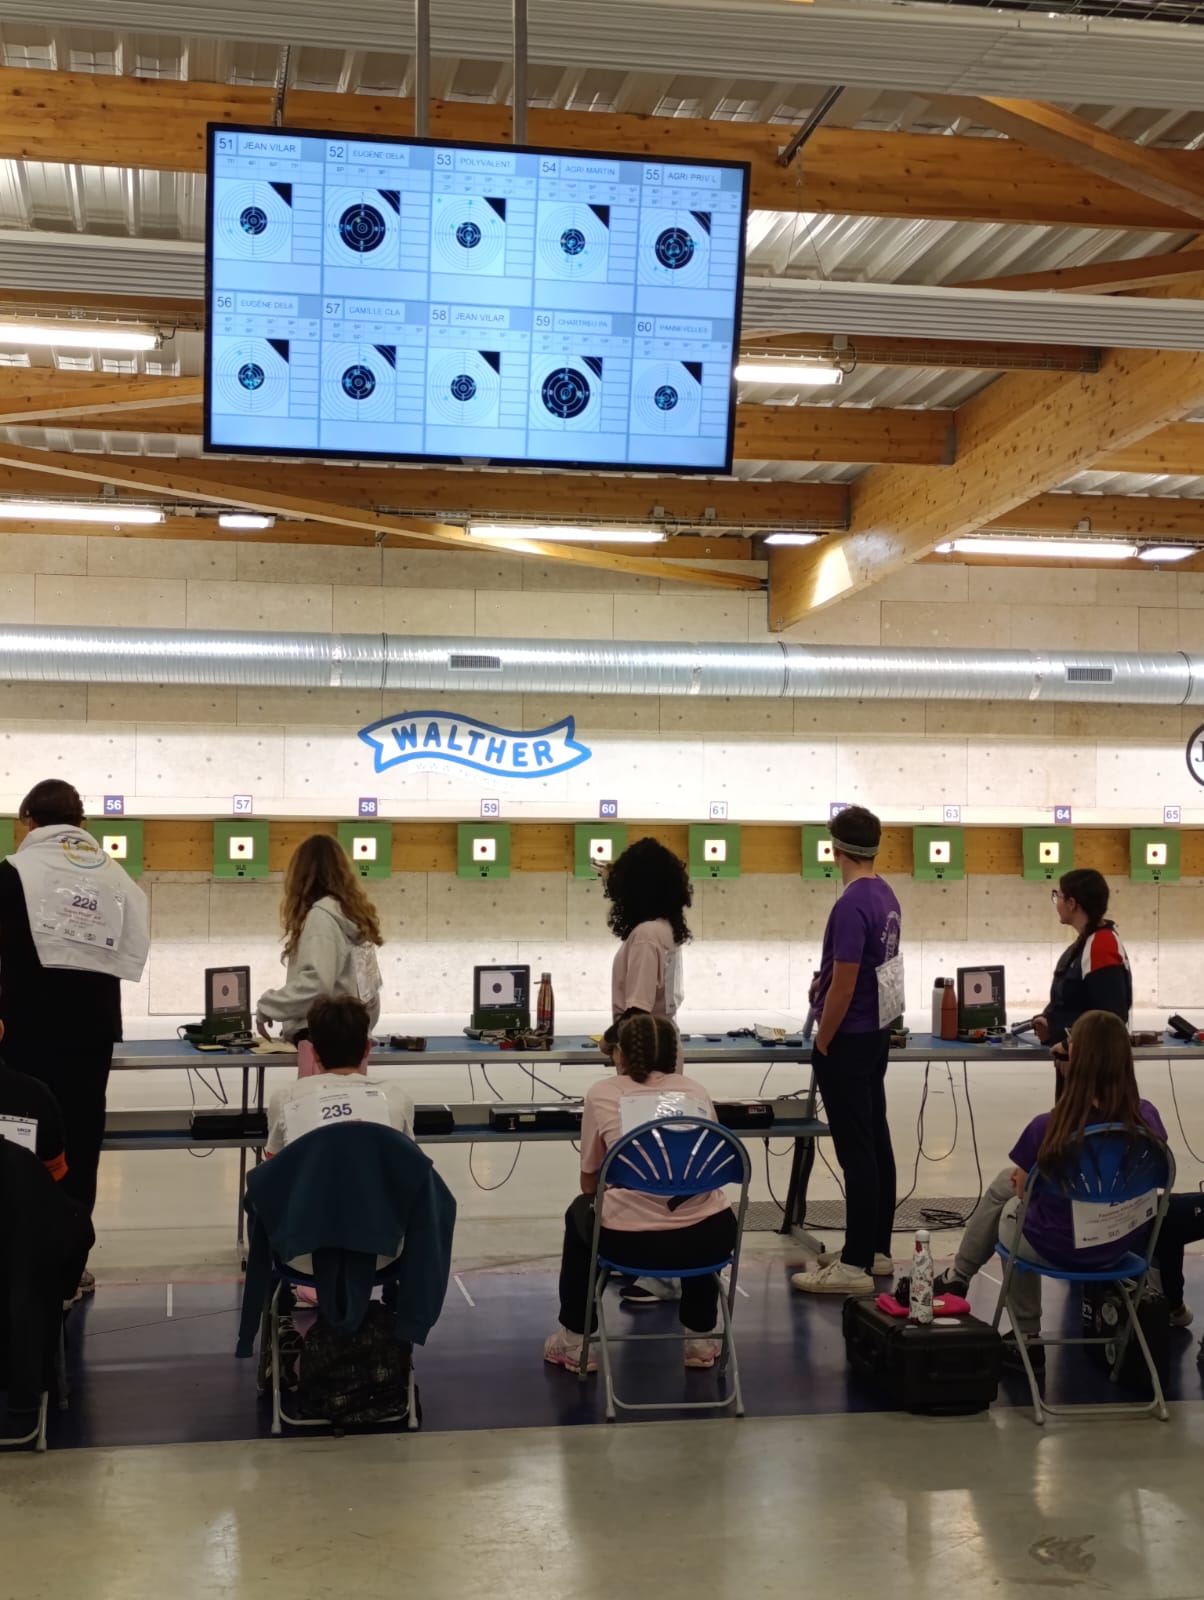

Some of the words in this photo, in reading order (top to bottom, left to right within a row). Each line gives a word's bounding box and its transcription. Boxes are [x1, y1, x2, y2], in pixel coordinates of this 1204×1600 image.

[219, 137, 233, 150] 51
[243, 141, 267, 151] JEAN
[269, 143, 296, 153] VILAR
[329, 146, 344, 158] 52
[436, 154, 452, 166] 53
[542, 161, 556, 173] 54
[646, 168, 660, 181] 55
[217, 296, 232, 308] 56
[326, 302, 341, 314] 57
[432, 309, 447, 321] 58
[455, 312, 478, 321] JEAN
[479, 314, 505, 323] VILAR
[536, 315, 551, 327] 59
[638, 321, 652, 333] 60
[391, 721, 554, 768] WALTHER
[106, 799, 122, 811] 56
[236, 799, 250, 811] 57
[361, 801, 376, 813] 58
[483, 802, 498, 814] 59
[601, 803, 616, 815] 60
[712, 805, 725, 817] 61
[945, 808, 959, 819] 63
[1056, 809, 1070, 821] 64
[1166, 809, 1179, 820] 65
[71, 895, 98, 912] 228
[321, 1103, 353, 1121] 235
